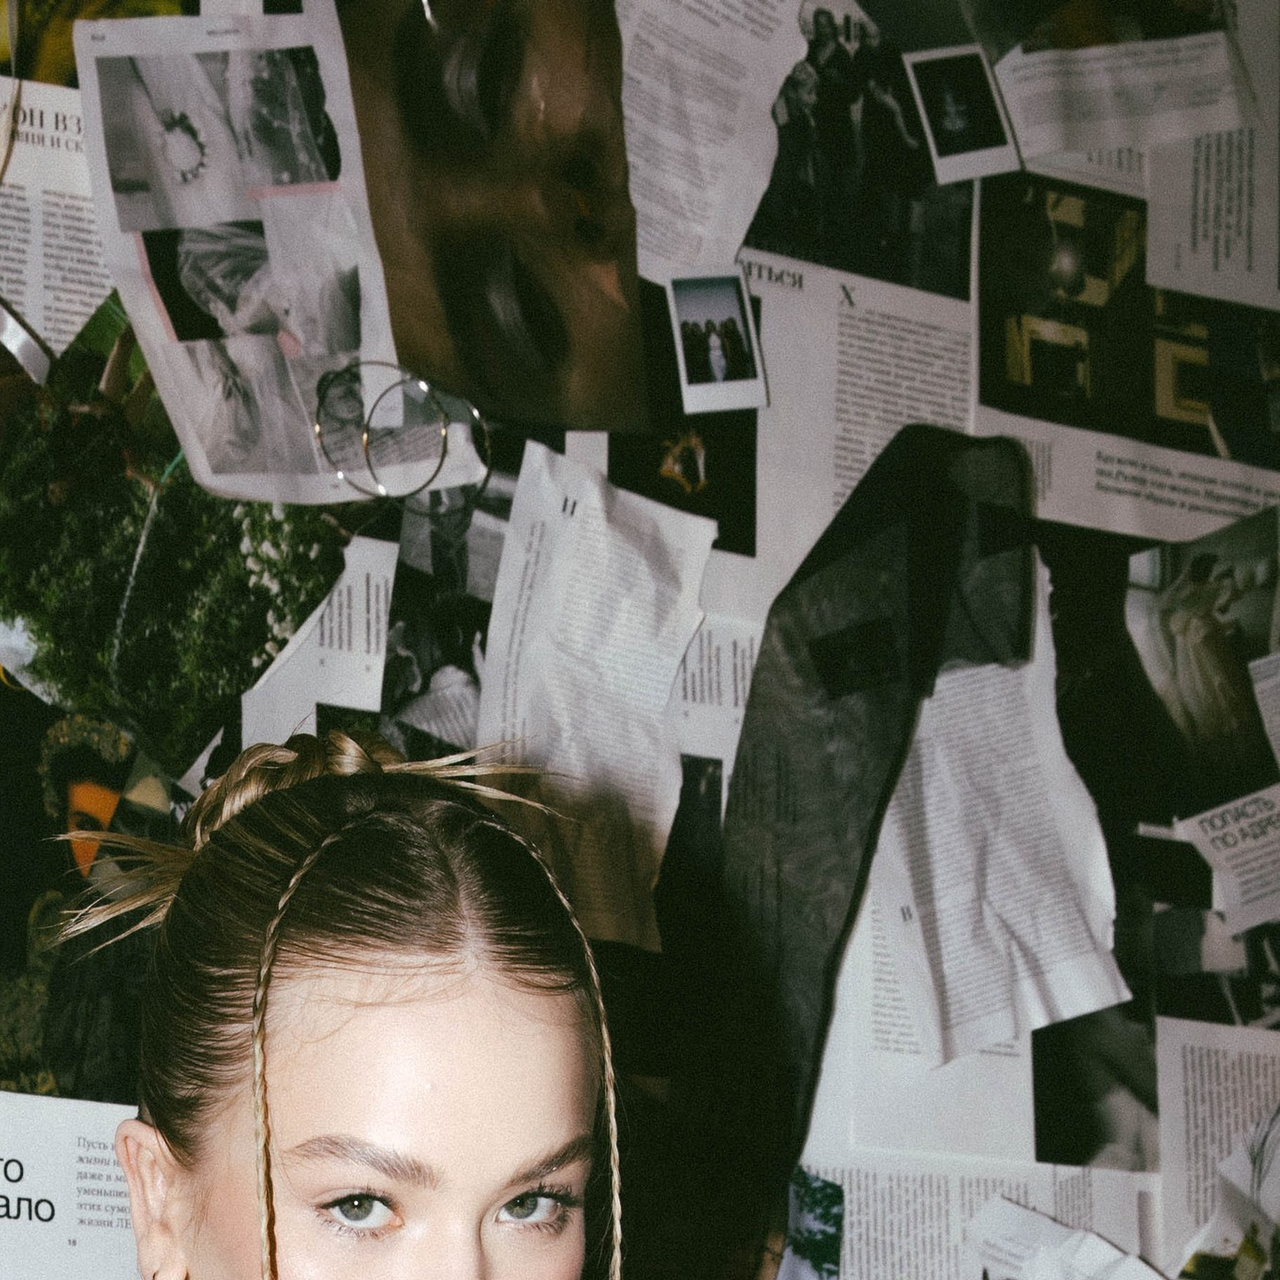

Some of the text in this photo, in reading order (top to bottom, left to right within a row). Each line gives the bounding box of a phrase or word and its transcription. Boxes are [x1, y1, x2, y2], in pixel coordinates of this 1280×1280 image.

[77, 1137, 109, 1152] Пусть
[76, 1155, 110, 1167] жизни
[76, 1171, 102, 1183] даже
[77, 1219, 113, 1228] жизни
